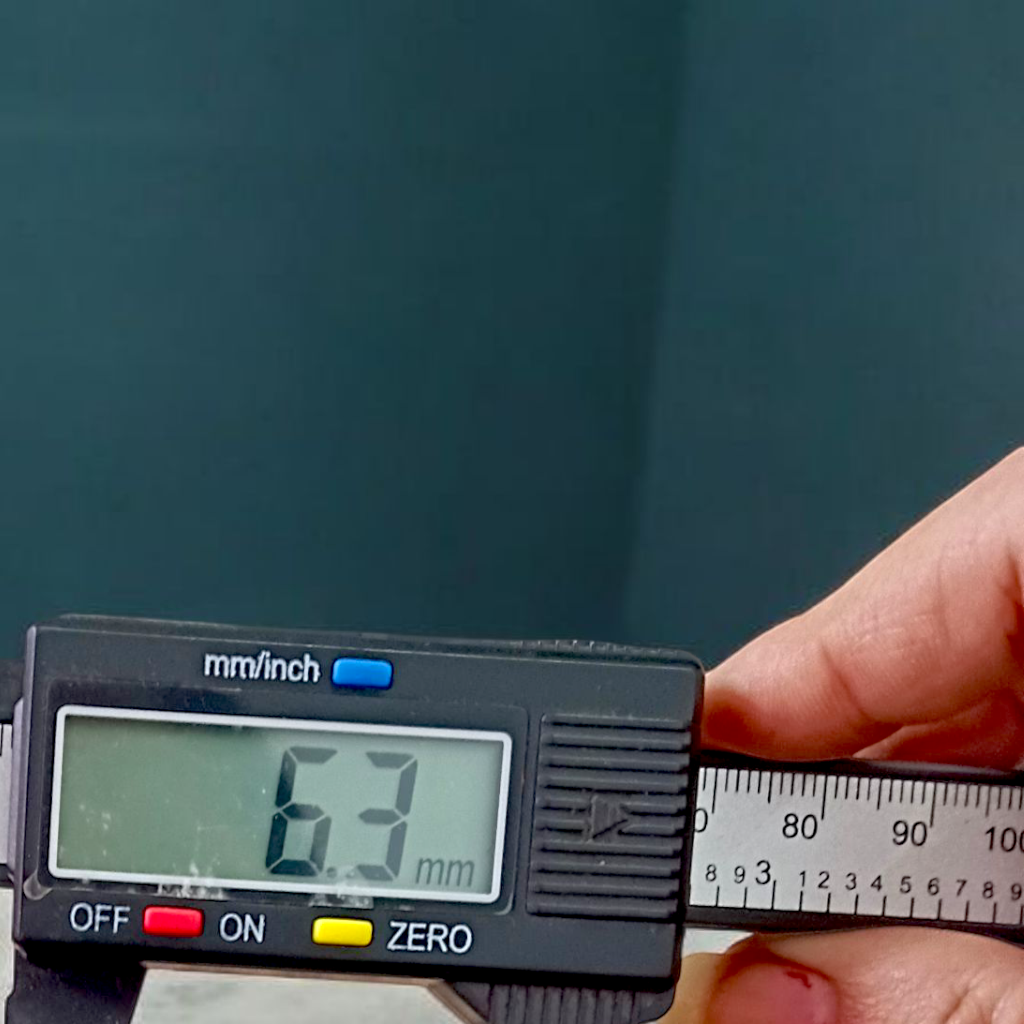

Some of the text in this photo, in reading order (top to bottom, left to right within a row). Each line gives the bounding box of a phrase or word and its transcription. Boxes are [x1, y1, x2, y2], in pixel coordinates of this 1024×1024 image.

[204, 650, 320, 683] mm/inch
[782, 813, 818, 839] 80
[892, 820, 927, 846] 90
[414, 857, 476, 887] mm
[705, 860, 1023, 901] 8 9 3 1 2 3 4 5 6 7 8 9
[69, 902, 130, 933] OFF
[219, 913, 266, 943] ON
[386, 920, 472, 954] ZERO
